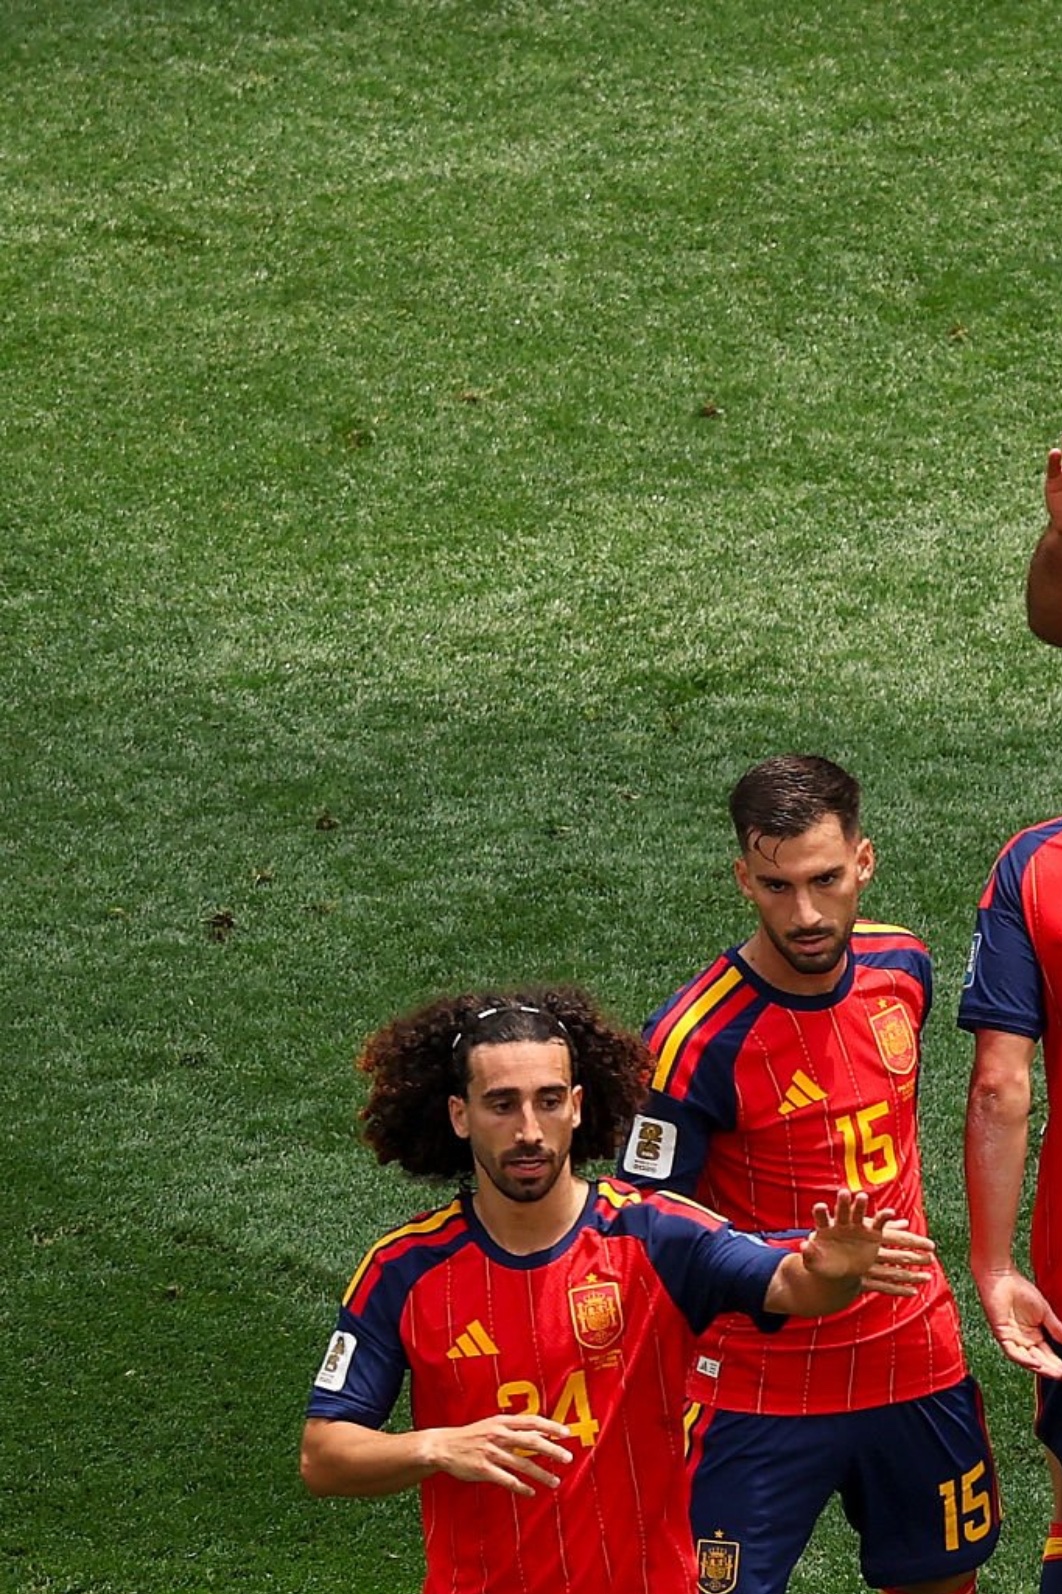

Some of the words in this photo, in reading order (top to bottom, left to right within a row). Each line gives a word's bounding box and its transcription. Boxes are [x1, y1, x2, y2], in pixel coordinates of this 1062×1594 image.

[835, 1100, 899, 1192] 15
[497, 1370, 599, 1457] 24
[939, 1460, 991, 1551] 15
